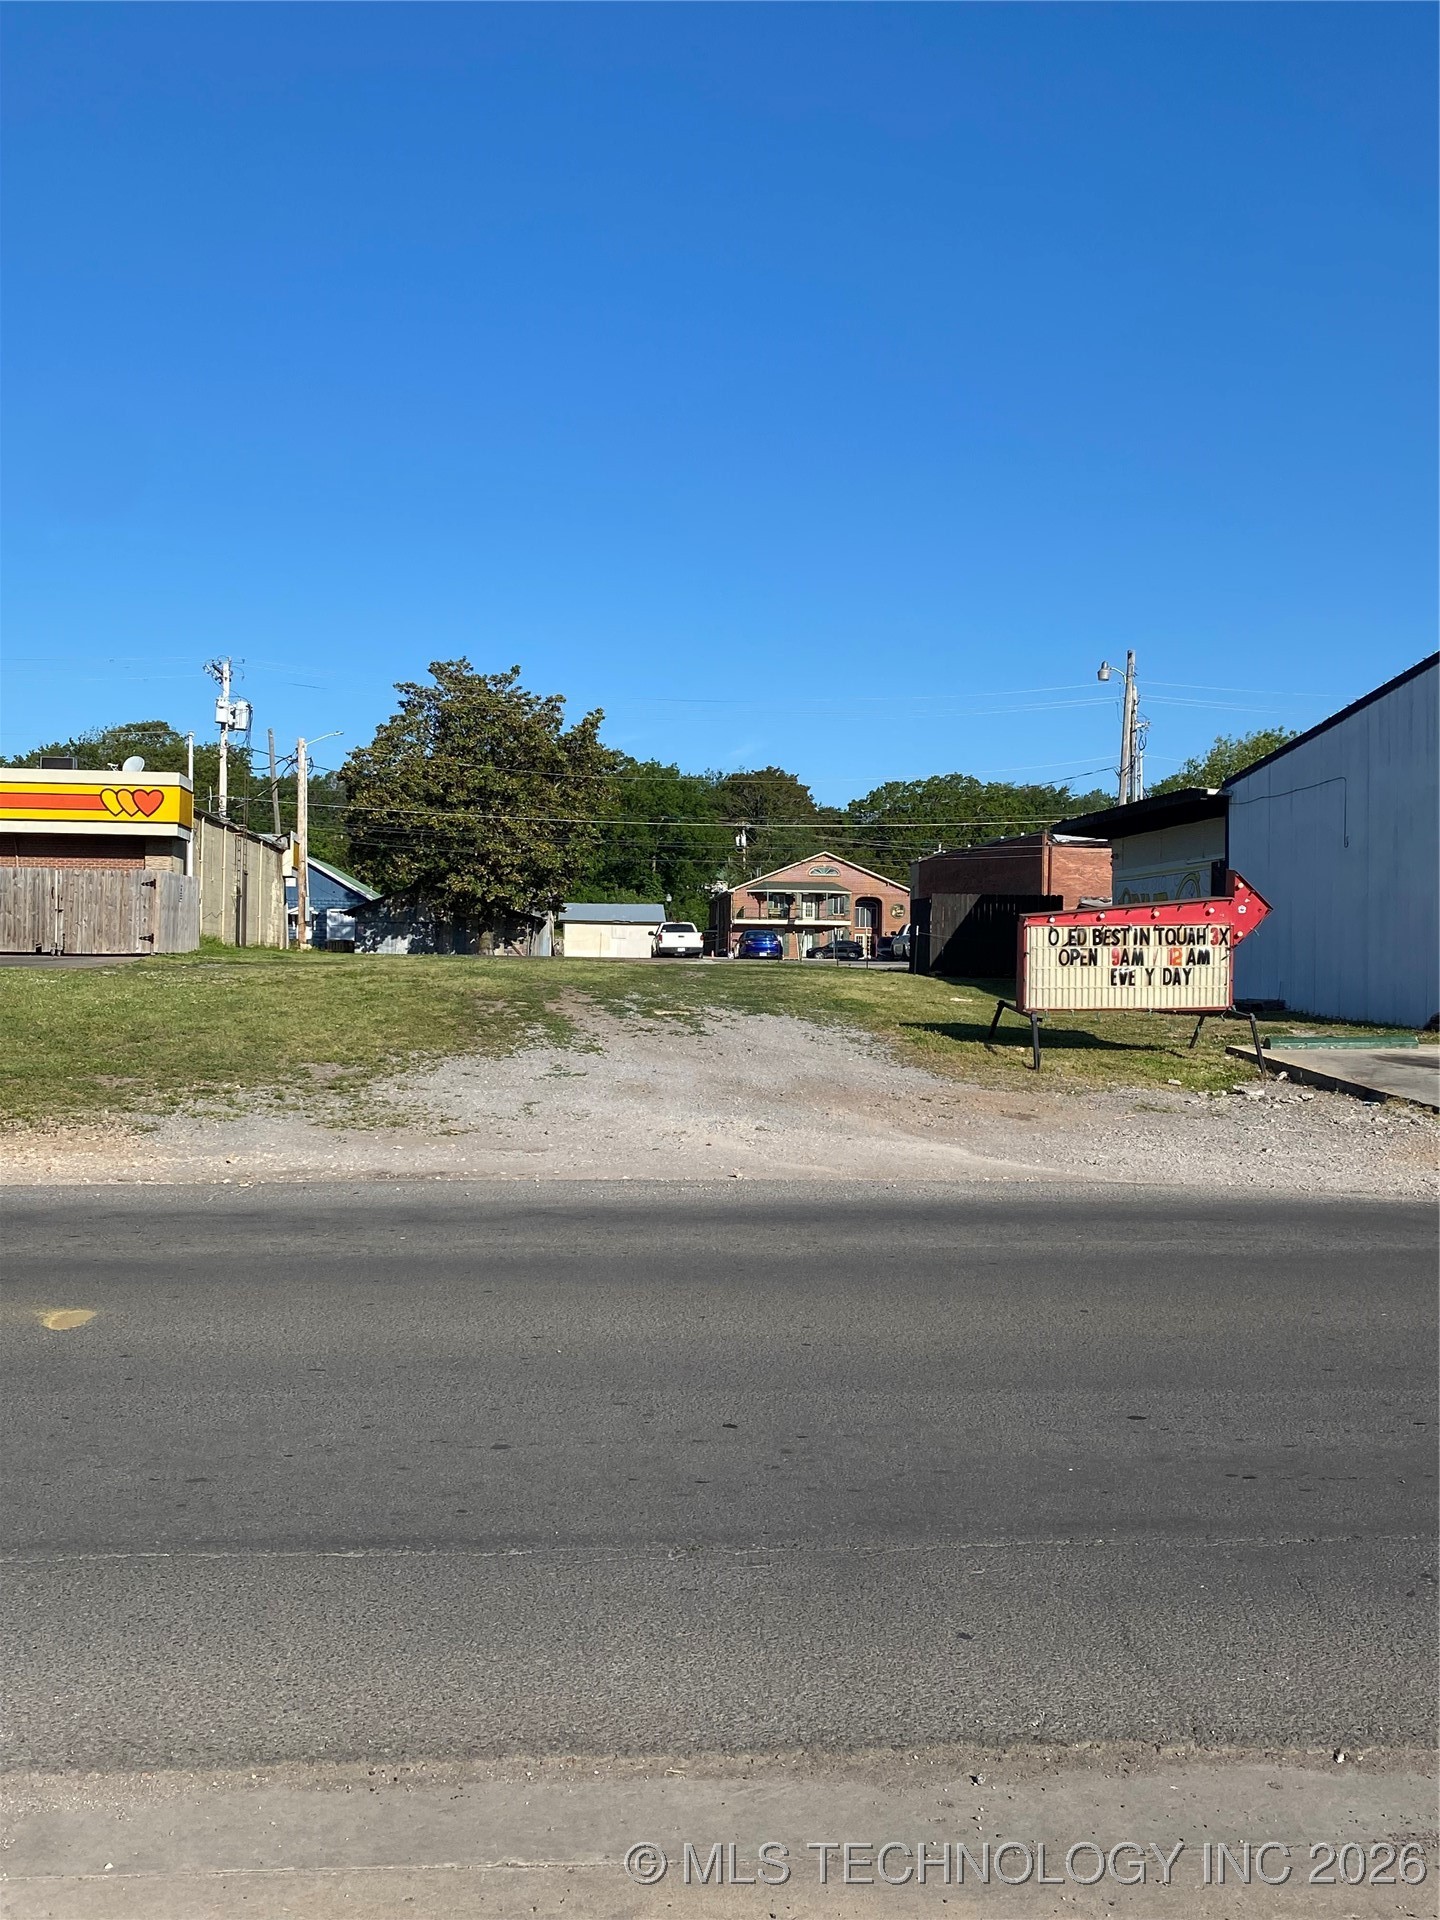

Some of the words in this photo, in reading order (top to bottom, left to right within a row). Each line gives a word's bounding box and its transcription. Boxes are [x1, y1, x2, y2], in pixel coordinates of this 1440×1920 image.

[1092, 928, 1130, 946] BEST
[1133, 928, 1150, 946] IN
[1155, 928, 1207, 946] TQUAH
[1058, 947, 1098, 966] OPEN
[1111, 947, 1144, 966] 9AM
[1163, 968, 1192, 986] DAY
